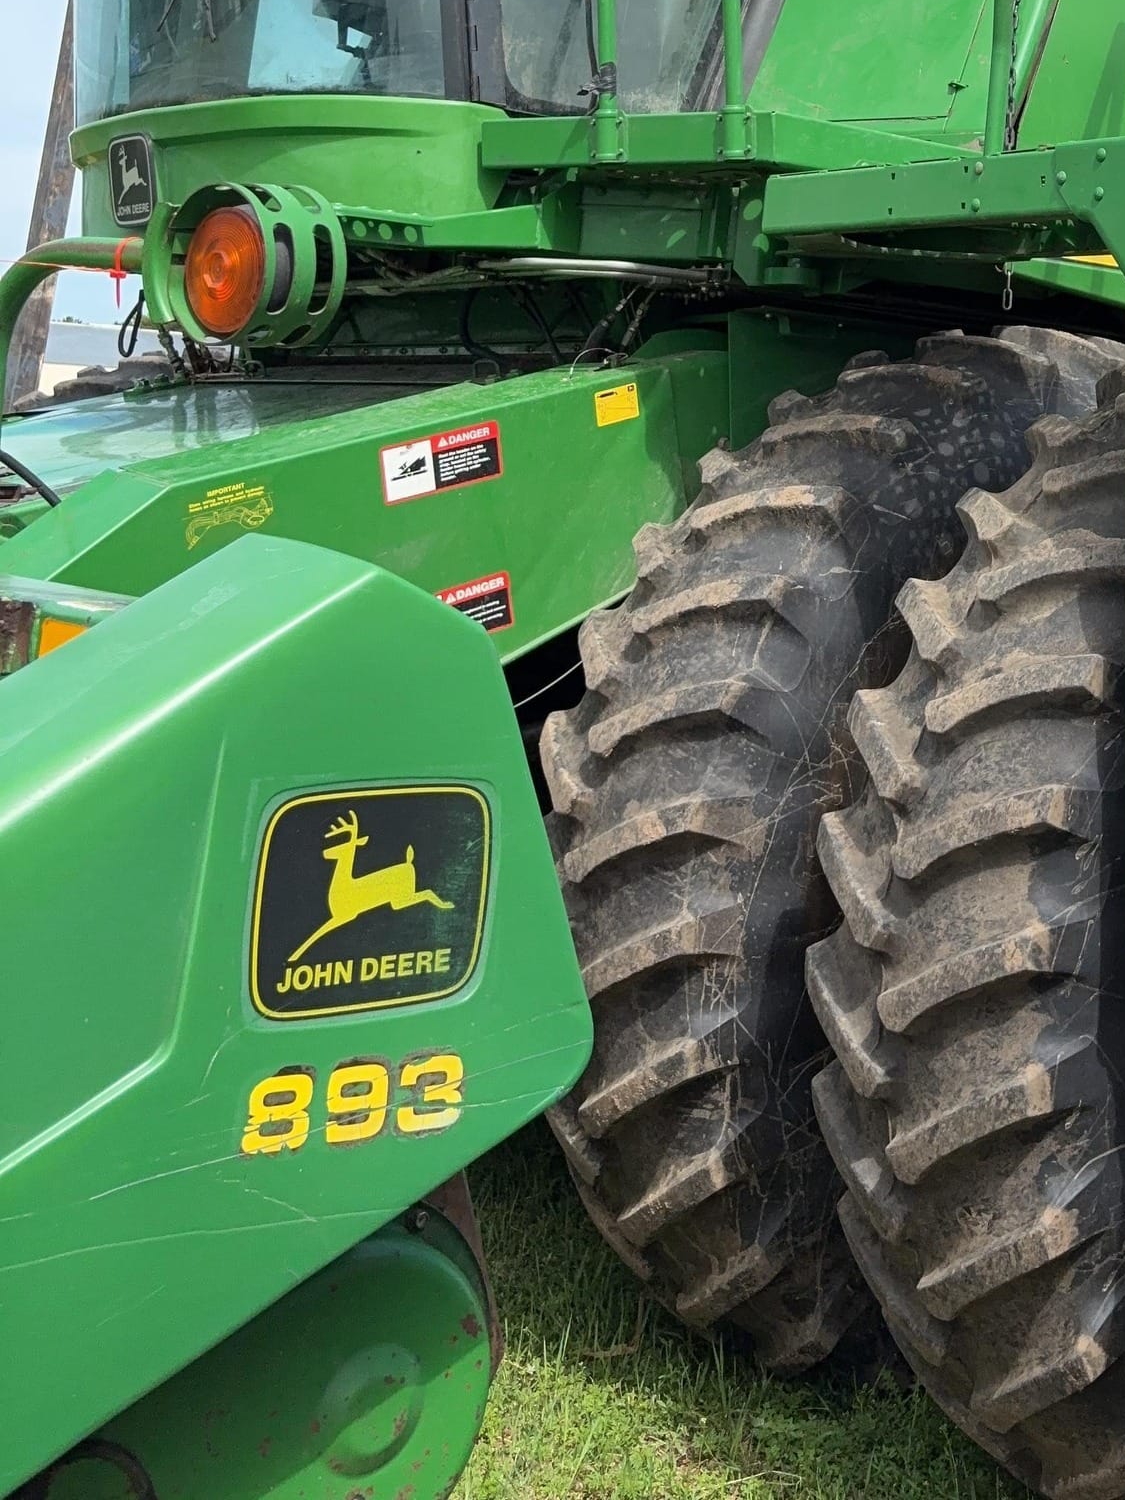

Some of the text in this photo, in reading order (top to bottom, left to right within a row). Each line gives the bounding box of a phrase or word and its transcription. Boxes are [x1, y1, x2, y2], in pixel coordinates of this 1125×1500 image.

[117, 202, 150, 217] JOHN DEERE
[448, 427, 490, 445] DANGER
[207, 483, 245, 497] IMPORTANT
[456, 577, 505, 600] DANGER
[276, 948, 451, 993] JOHN DEERE
[241, 1054, 464, 1154] 893
